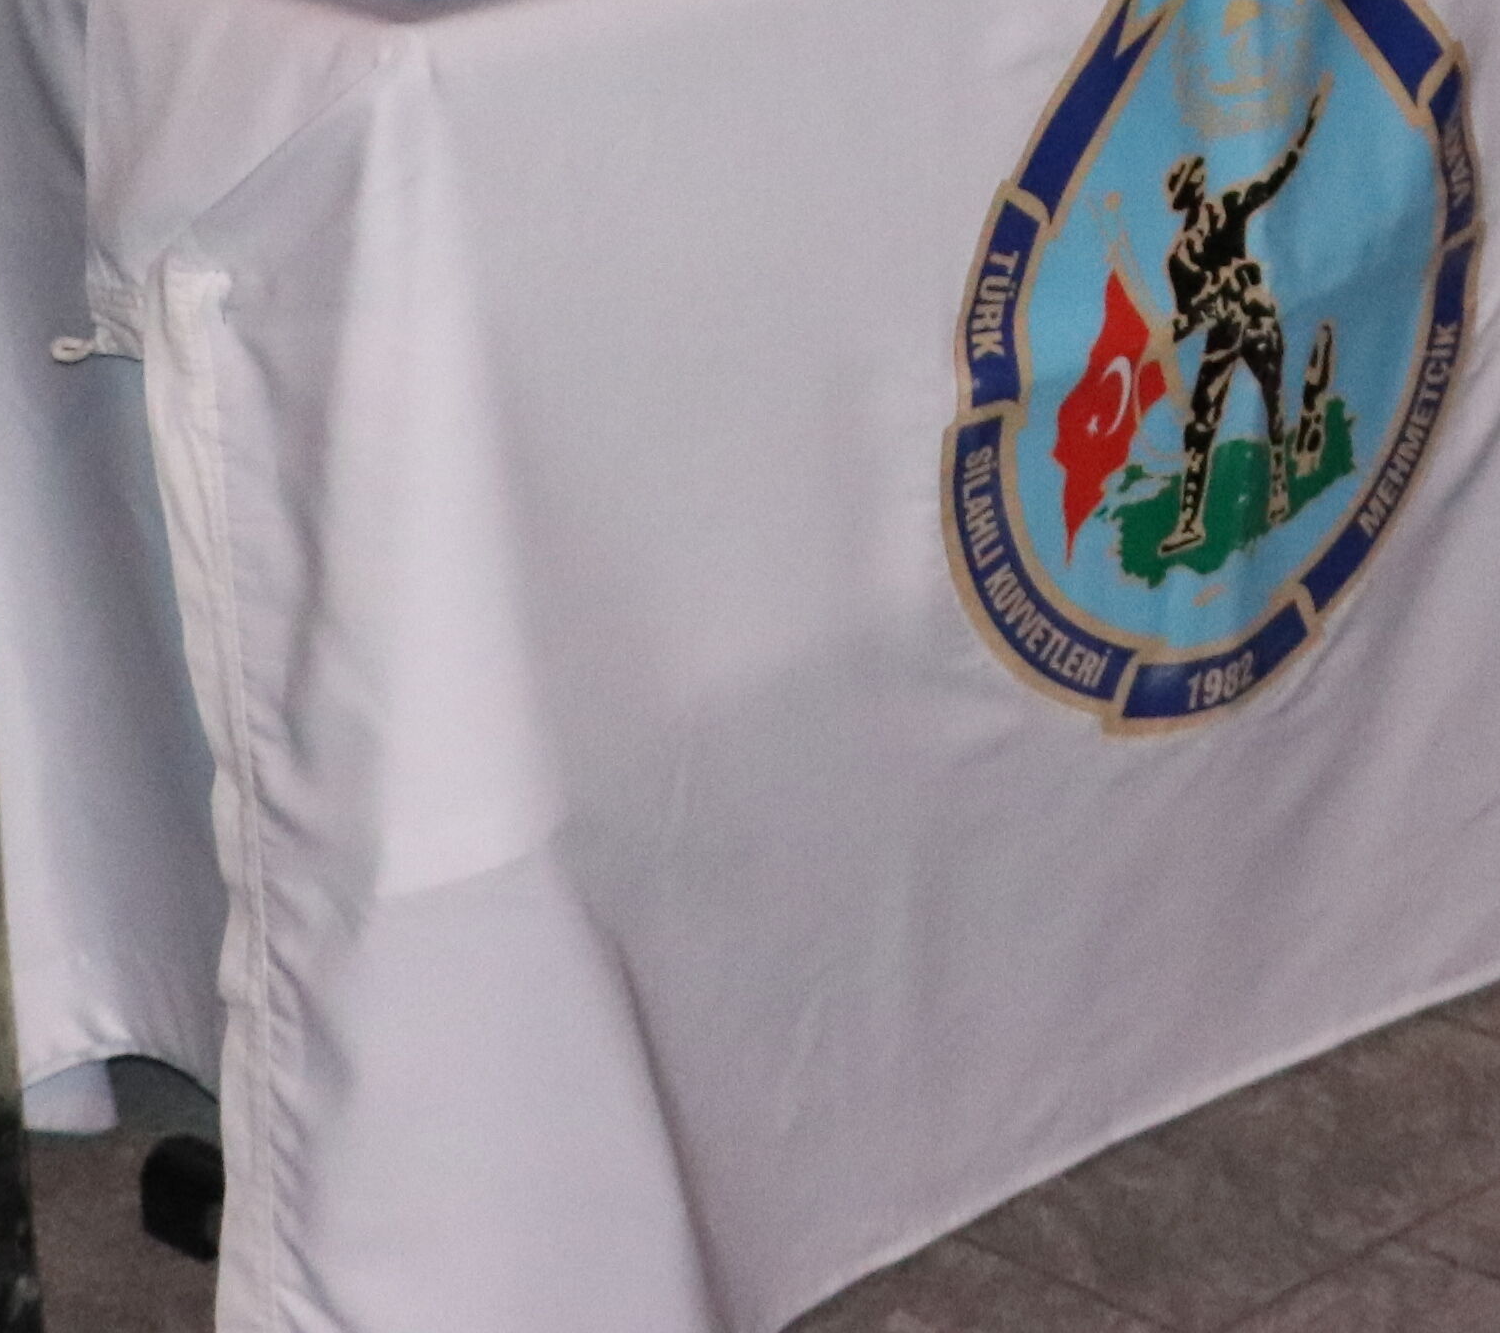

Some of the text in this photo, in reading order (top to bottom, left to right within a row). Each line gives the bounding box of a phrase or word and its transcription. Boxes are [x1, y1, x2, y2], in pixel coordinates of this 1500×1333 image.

[971, 249, 1019, 360] TÜRK
[962, 444, 1114, 689] SİLAHLI KUVVETLERİ
[1186, 649, 1255, 711] 1982
